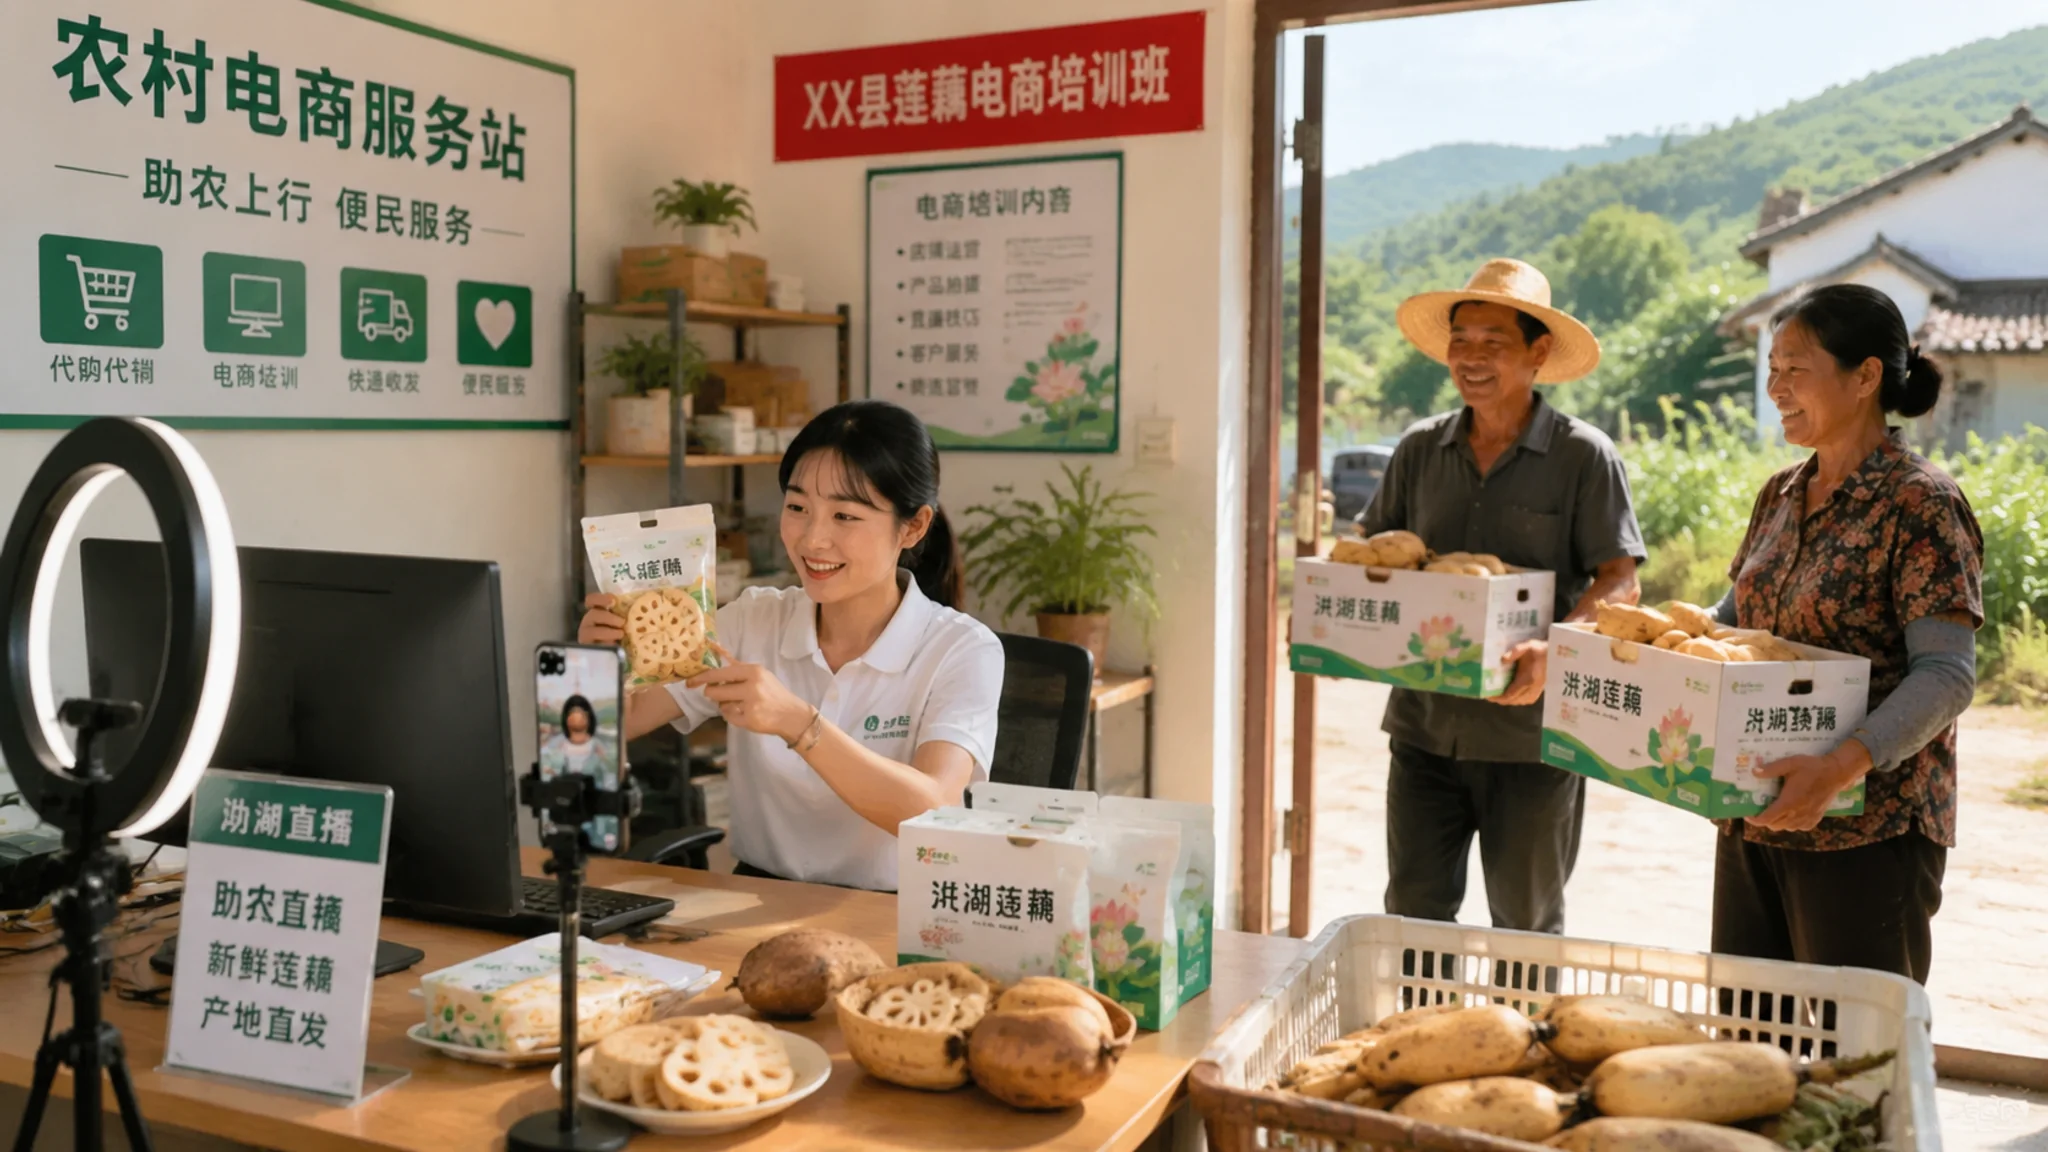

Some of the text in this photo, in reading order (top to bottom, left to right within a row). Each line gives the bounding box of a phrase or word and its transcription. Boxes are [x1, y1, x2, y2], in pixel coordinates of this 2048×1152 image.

[52, 14, 527, 182] 农村电商服务站
[803, 44, 1170, 130] XX县莲藕电商培训班
[142, 157, 473, 246] 助农上行 便民服务
[1313, 594, 1401, 625] 洪湖莲藕
[1562, 670, 1643, 717] 洪湖莲藕
[931, 880, 1055, 924] 洪湖莲藕
[207, 939, 334, 994] 新鲜莲藕
[200, 996, 328, 1049] 产地直发
